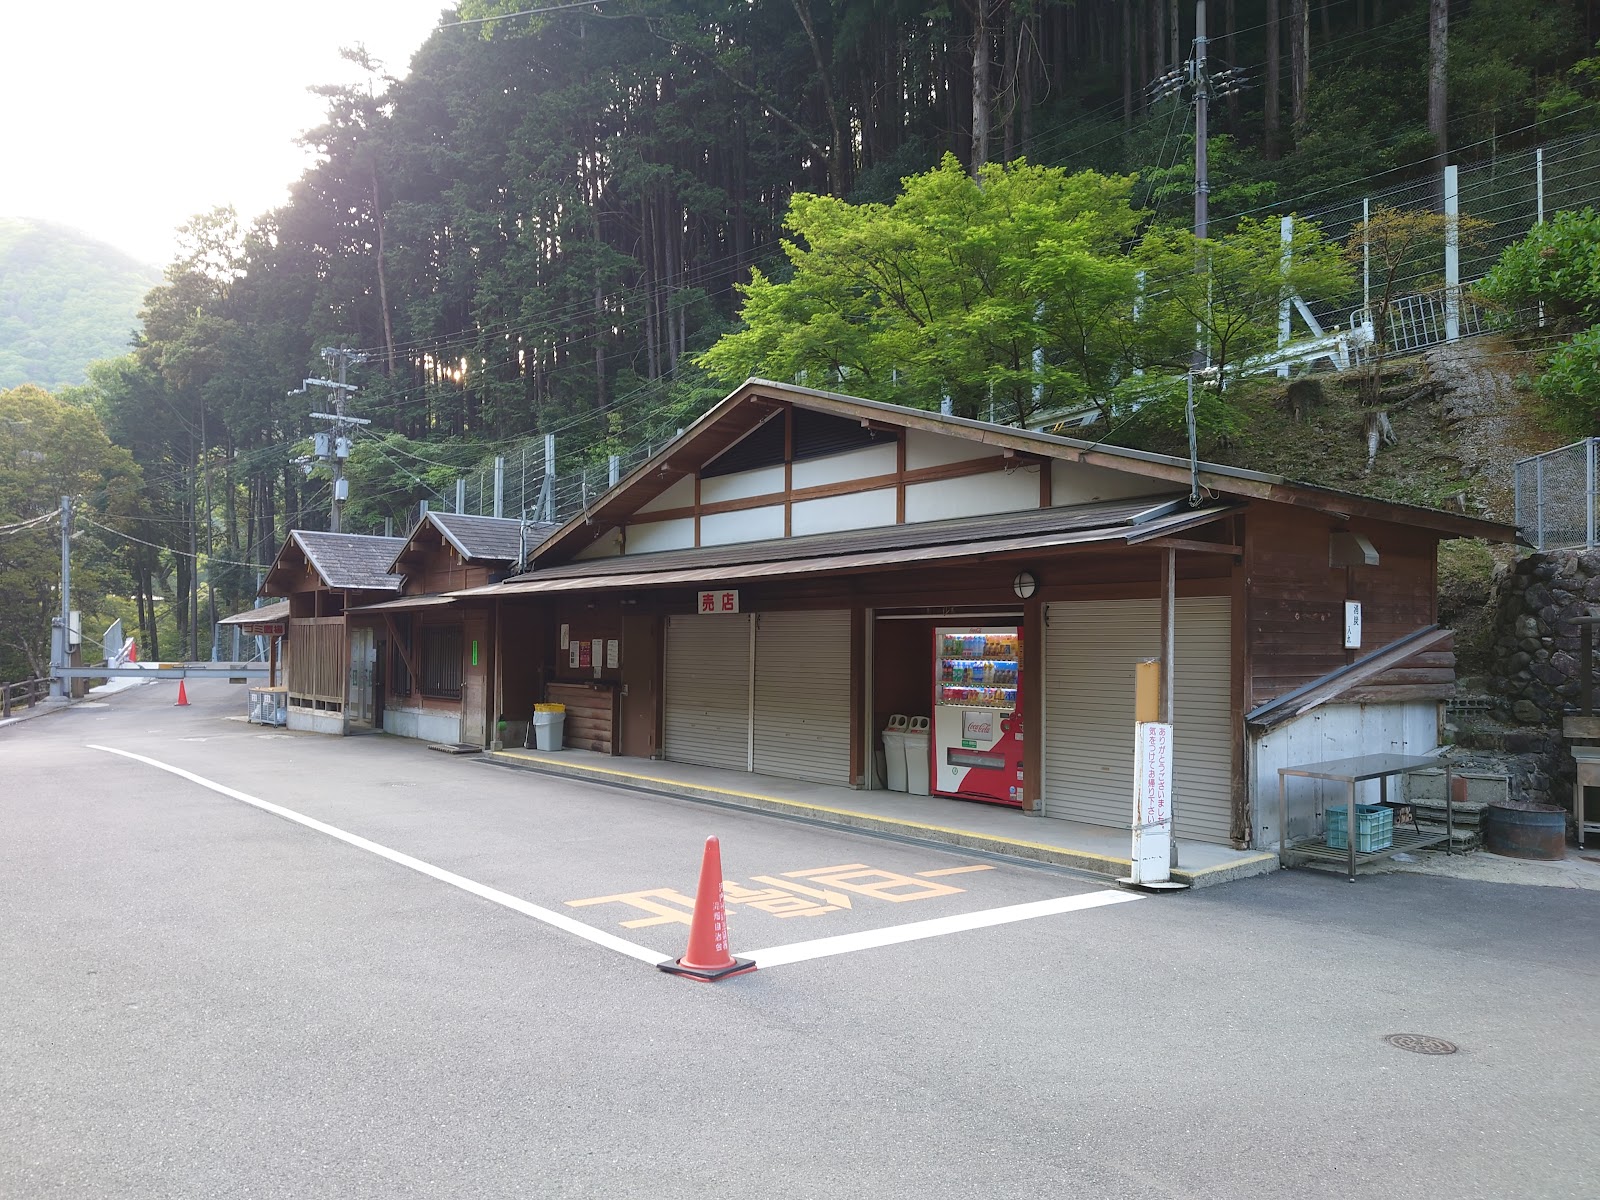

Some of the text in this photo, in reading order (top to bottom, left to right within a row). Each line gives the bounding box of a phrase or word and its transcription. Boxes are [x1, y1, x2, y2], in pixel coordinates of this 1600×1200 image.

[702, 592, 734, 612] 売店
[1147, 727, 1156, 824] 気をつけてお帰り下さい
